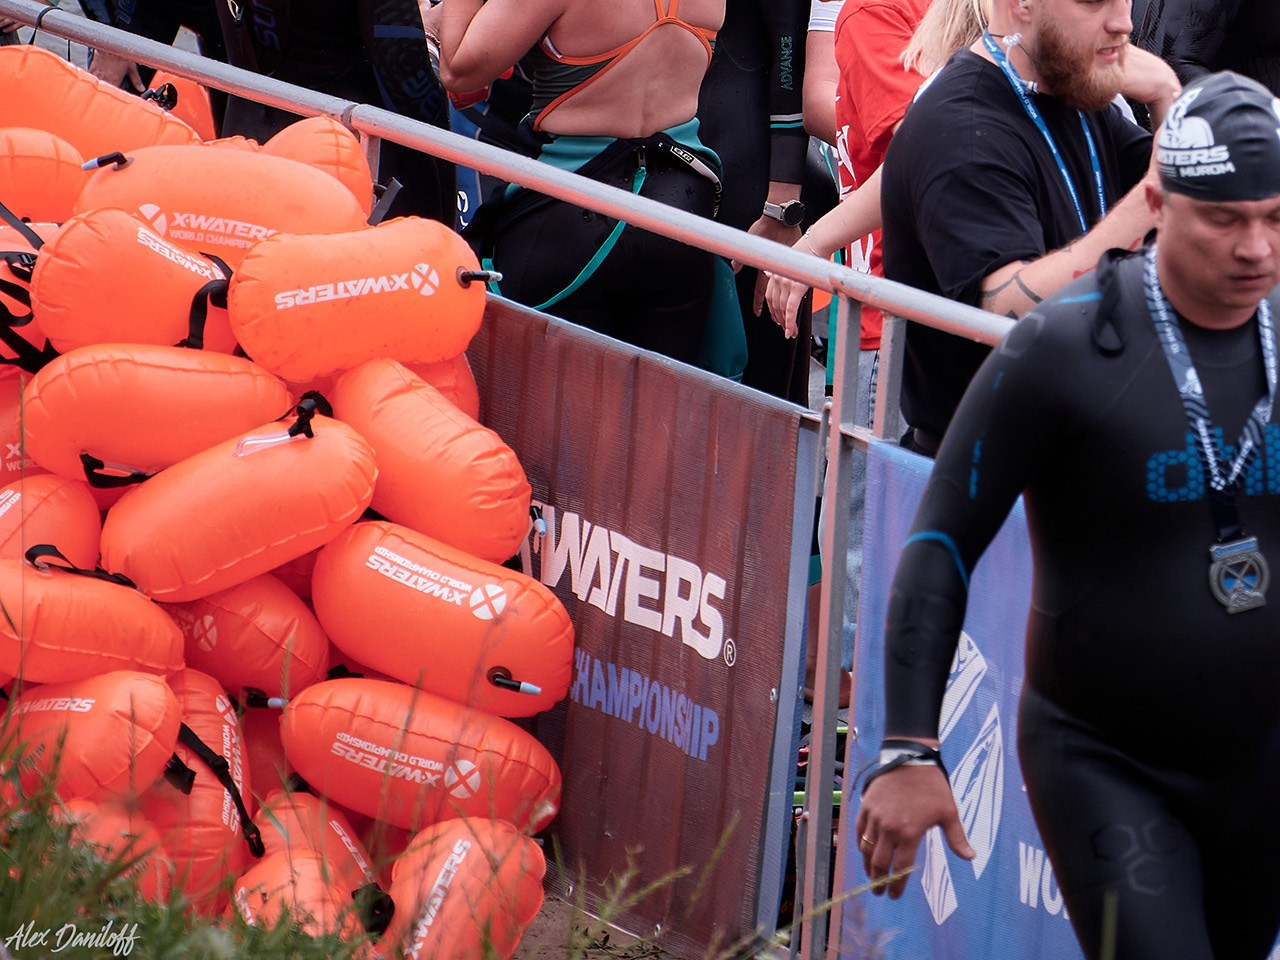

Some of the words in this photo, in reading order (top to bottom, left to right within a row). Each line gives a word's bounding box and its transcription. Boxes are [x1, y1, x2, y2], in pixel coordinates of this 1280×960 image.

[779, 35, 793, 91] ADVANCE
[1179, 161, 1236, 178] MUROM
[169, 229, 204, 244] WORLD
[374, 546, 441, 579] CHAMPIONSHIP
[440, 575, 473, 593] WORLD
[409, 756, 445, 772] WORLD
